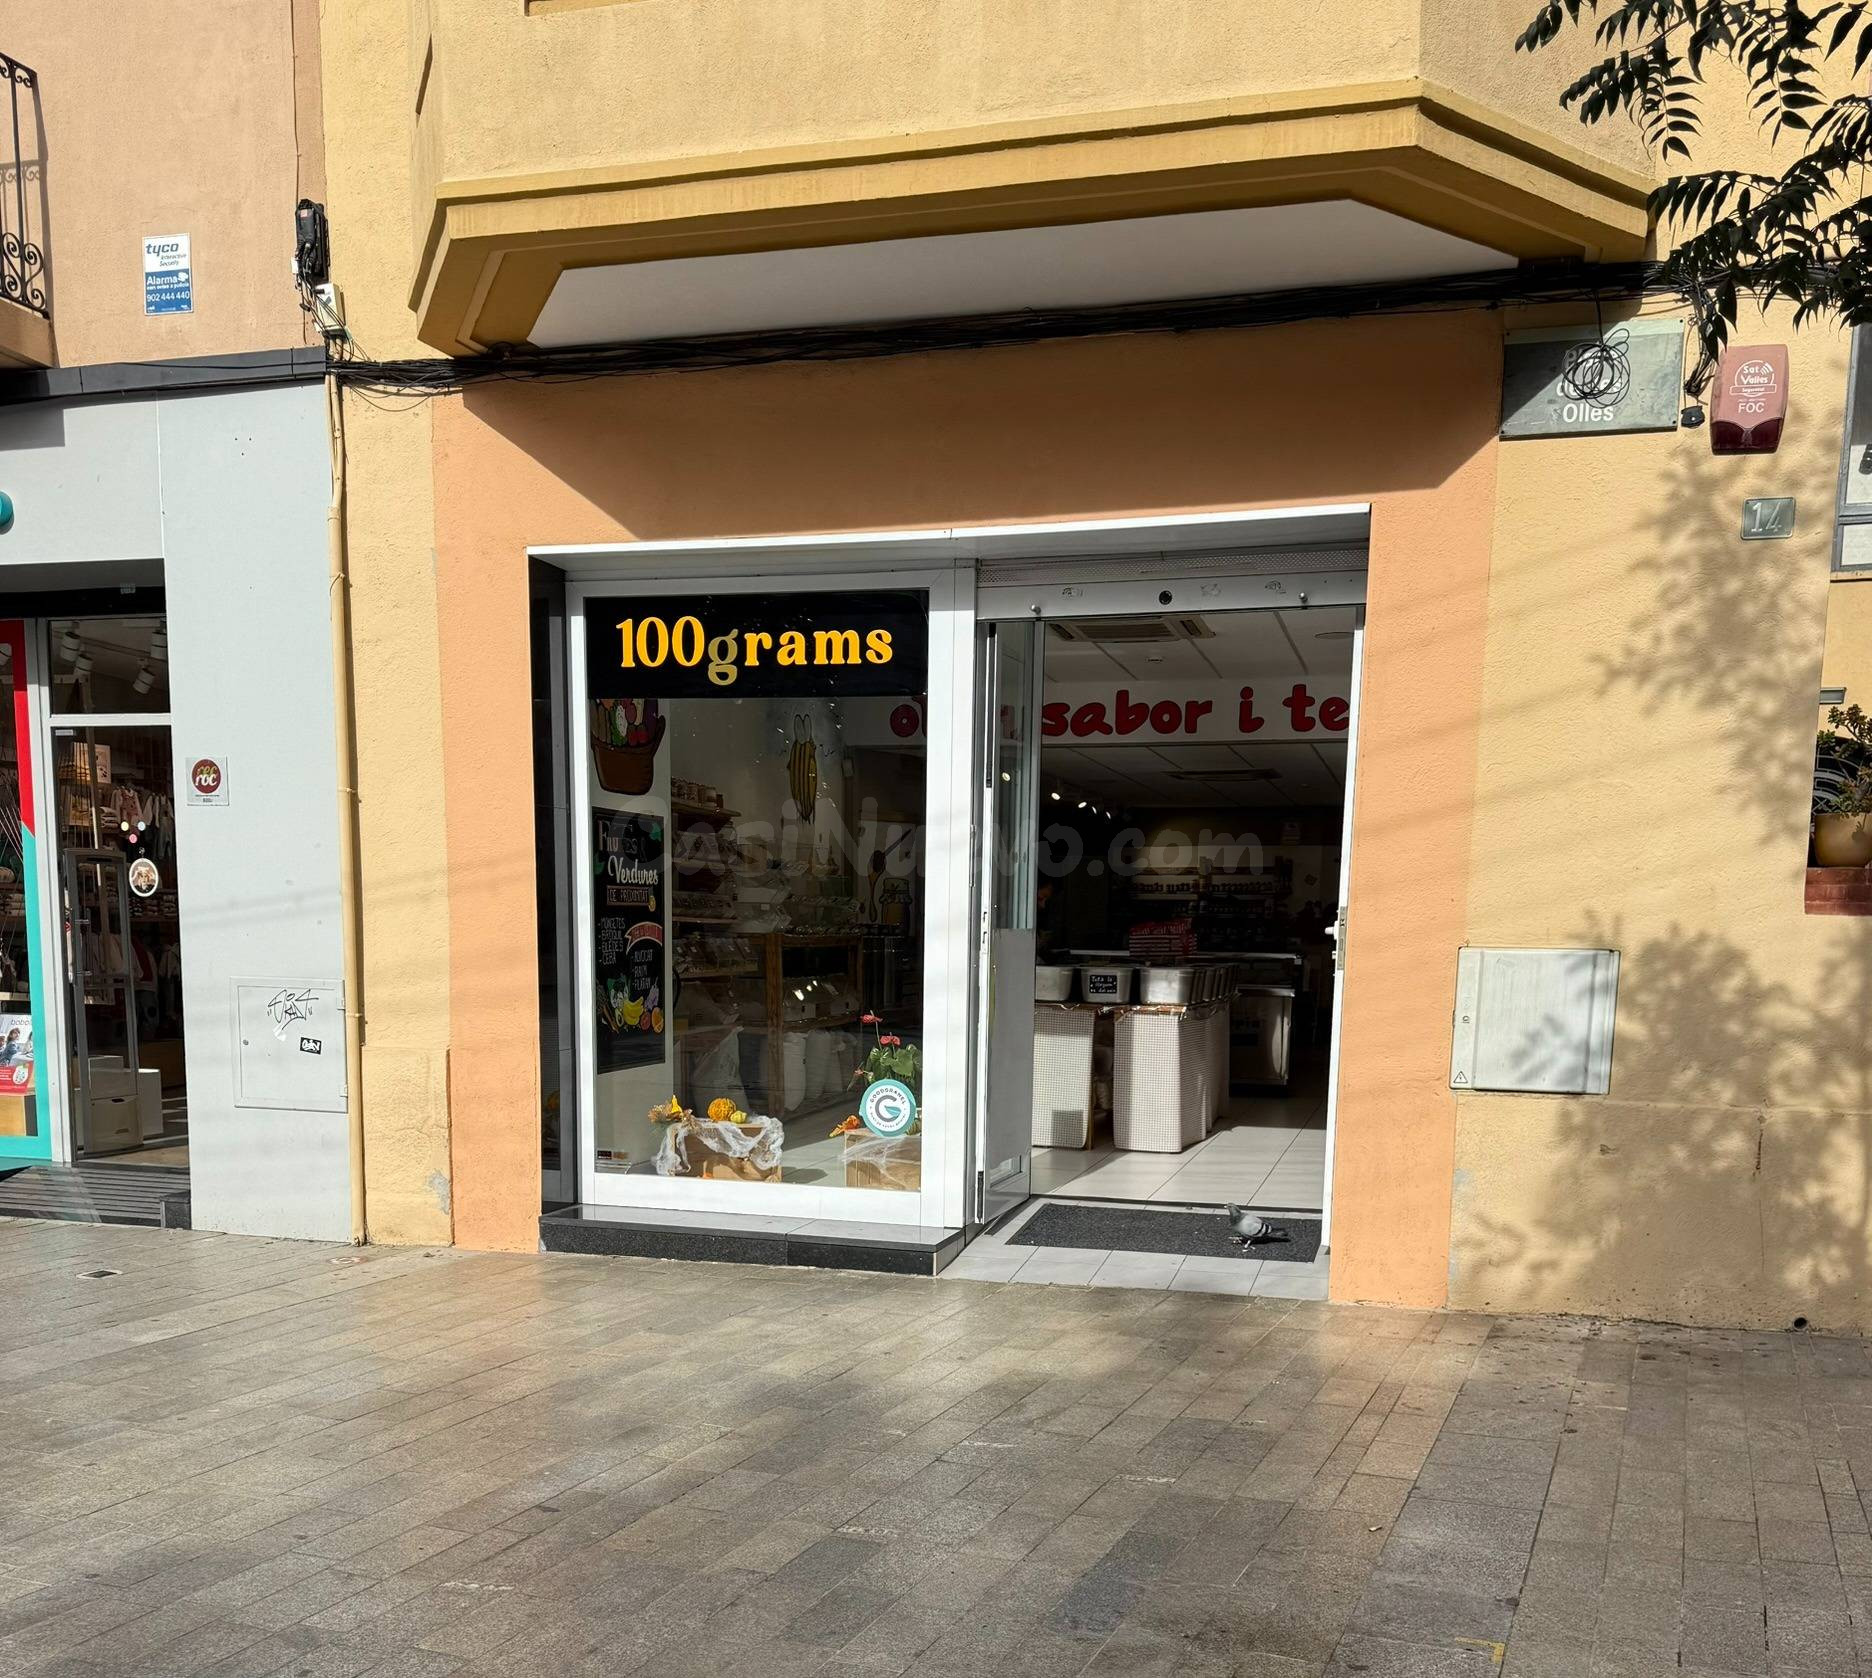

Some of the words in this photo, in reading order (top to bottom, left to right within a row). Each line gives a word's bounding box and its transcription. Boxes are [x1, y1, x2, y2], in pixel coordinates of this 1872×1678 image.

[146, 243, 179, 257] tyco
[147, 275, 178, 285] Alarma
[147, 293, 160, 302] 902
[161, 292, 175, 300] 444
[176, 291, 190, 299] 440
[1743, 366, 1760, 374] Sat
[1563, 403, 1614, 423] Olles
[1738, 402, 1766, 413] FOC
[1750, 502, 1783, 533] 14
[616, 615, 893, 686] 100grams
[1041, 689, 1213, 737] sabor
[1238, 686, 1265, 733] i
[607, 855, 658, 885] Verdures
